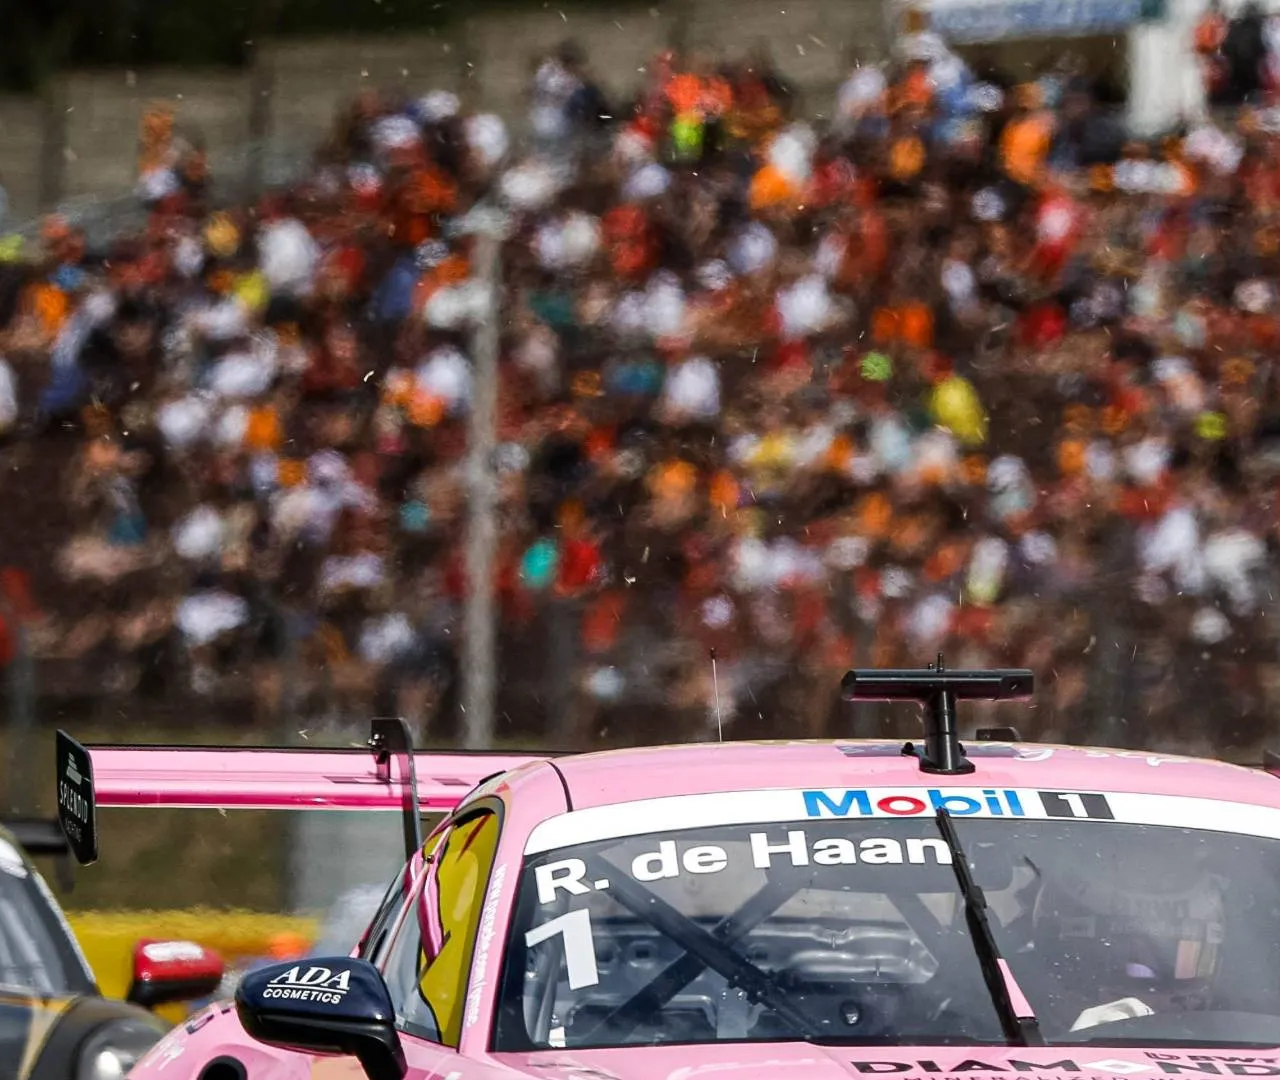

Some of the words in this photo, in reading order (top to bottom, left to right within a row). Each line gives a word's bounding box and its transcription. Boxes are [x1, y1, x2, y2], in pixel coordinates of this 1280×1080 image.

[802, 788, 1026, 818] Mobil
[1045, 791, 1100, 819] 1
[534, 857, 610, 905] R.
[631, 840, 729, 882] de
[749, 829, 954, 870] Haan
[525, 907, 600, 991] 1
[269, 965, 353, 991] ADA
[262, 988, 342, 1005] COSMETICS
[1186, 1054, 1280, 1065] BWT
